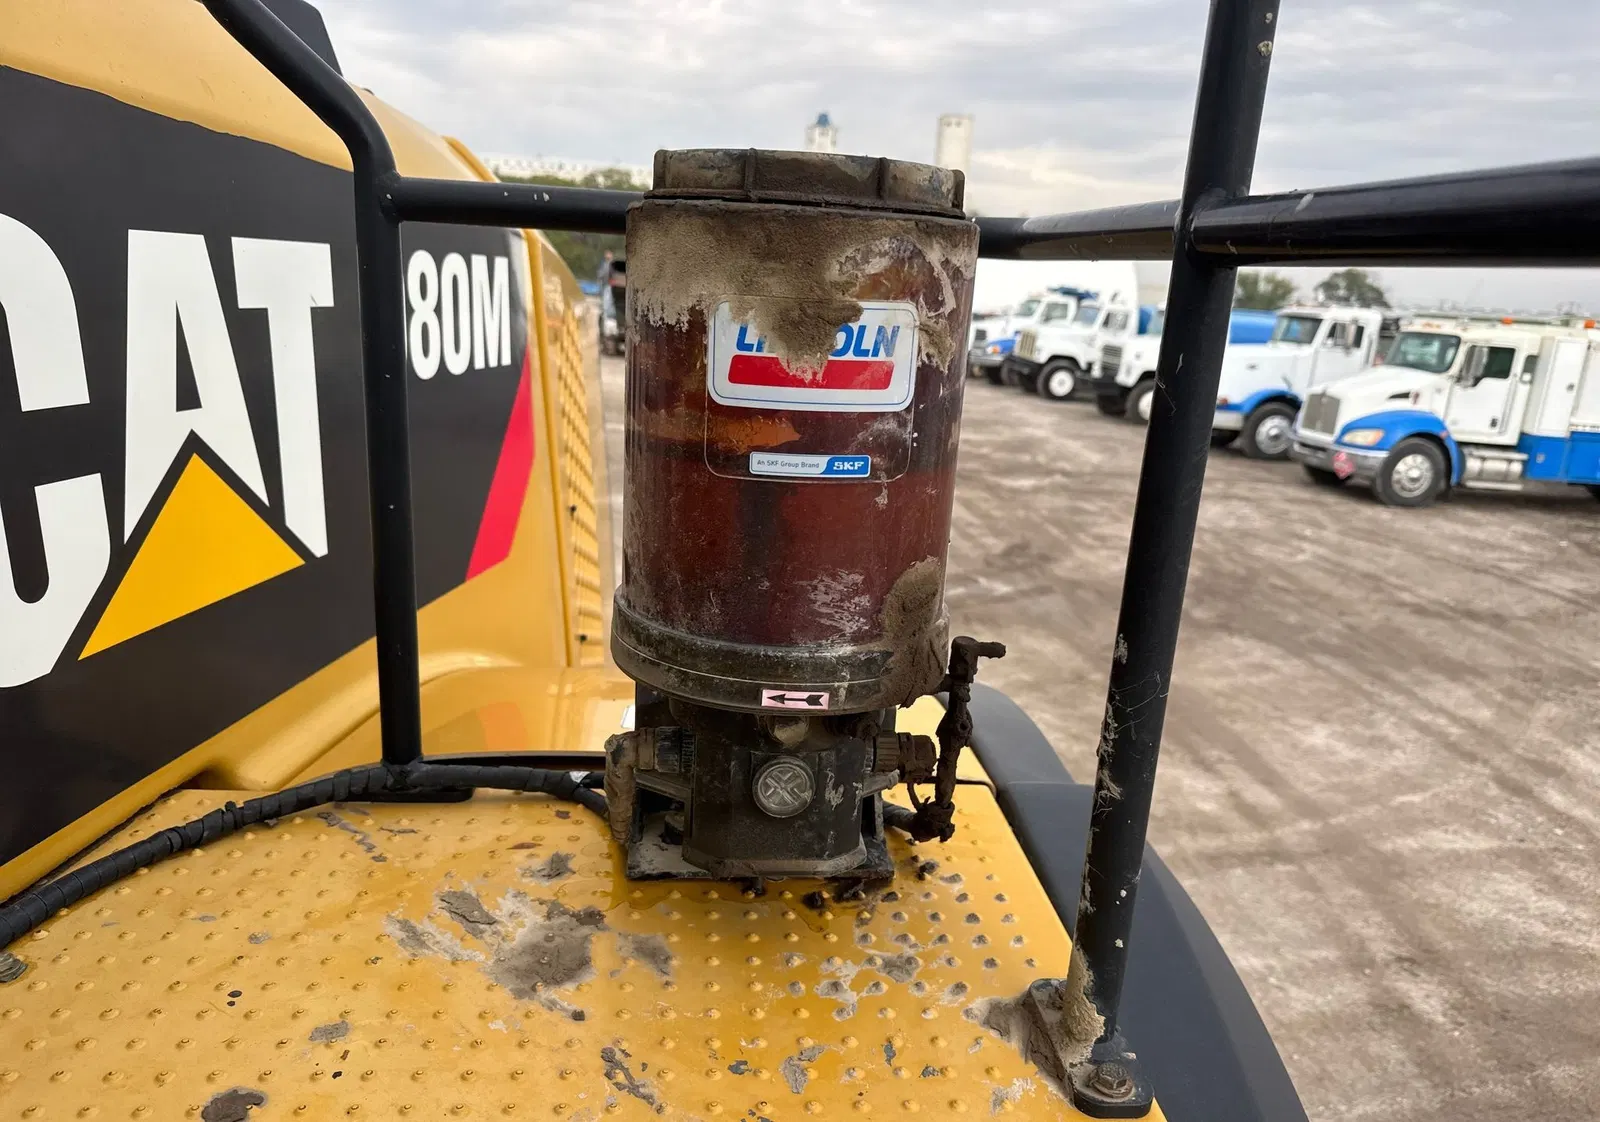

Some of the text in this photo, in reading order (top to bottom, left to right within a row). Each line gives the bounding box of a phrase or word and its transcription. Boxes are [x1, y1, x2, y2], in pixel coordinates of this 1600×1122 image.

[403, 249, 512, 380] 80M
[0, 213, 335, 688] CAT
[766, 459, 779, 467] SKF
[780, 460, 799, 469] Group
[801, 461, 820, 469] Brand
[833, 461, 865, 470] SKF
